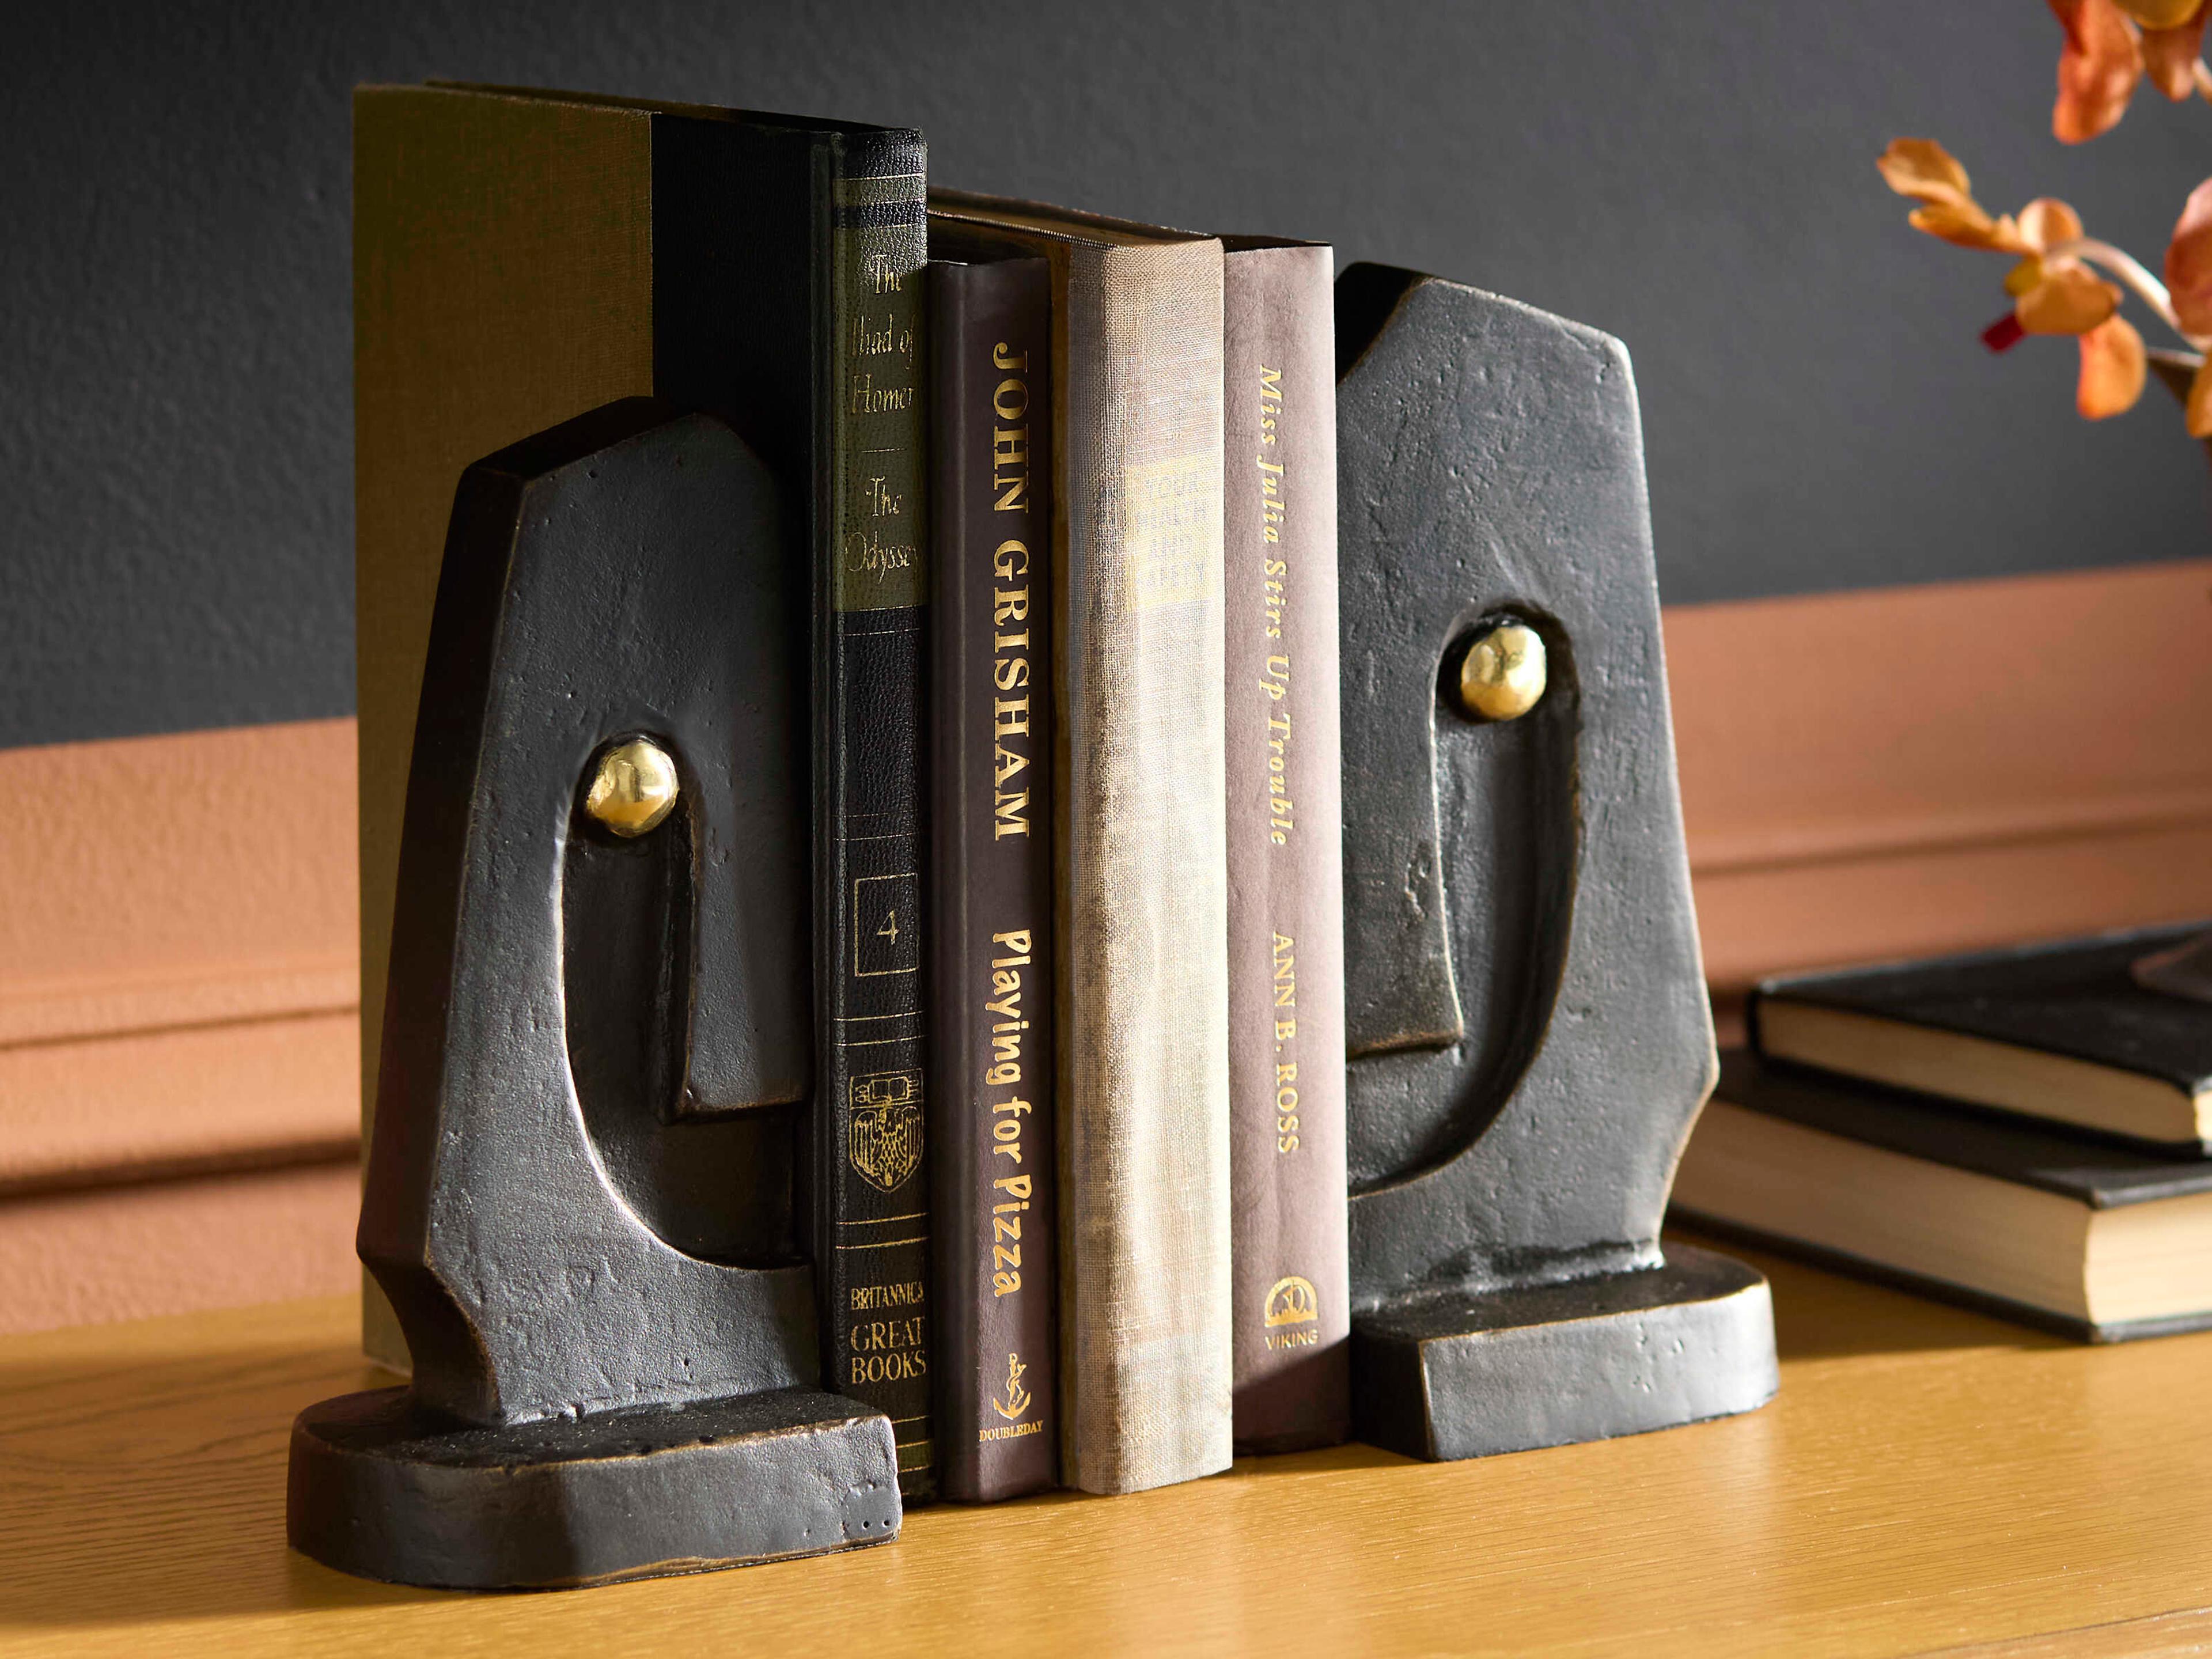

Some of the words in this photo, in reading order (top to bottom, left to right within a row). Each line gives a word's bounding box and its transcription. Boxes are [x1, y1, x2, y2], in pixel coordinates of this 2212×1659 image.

[866, 255, 903, 293] The
[851, 313, 893, 357] Iliad
[851, 373, 914, 414] Homer
[1259, 364, 1283, 445] Miss
[993, 342, 1029, 513] JOHN
[866, 475, 903, 516] The
[1256, 454, 1286, 544] Julia
[1264, 558, 1288, 639] Stirs
[993, 539, 1030, 842] GRISHAM
[1259, 654, 1291, 701] Up
[1268, 713, 1294, 846] Trouble
[876, 910, 899, 945] 4
[1273, 930, 1296, 1007] ANN
[985, 929, 1033, 1085] Playing
[1275, 1018, 1298, 1052] B.
[992, 1096, 1032, 1164] for
[1277, 1061, 1300, 1154] ROSS
[992, 1173, 1033, 1297] Pizza
[850, 1317, 925, 1352] GREAT
[1264, 1329, 1319, 1350] VIKING
[851, 1350, 927, 1384] BOOKS
[979, 1419, 1043, 1442] DOUBLEDAY
